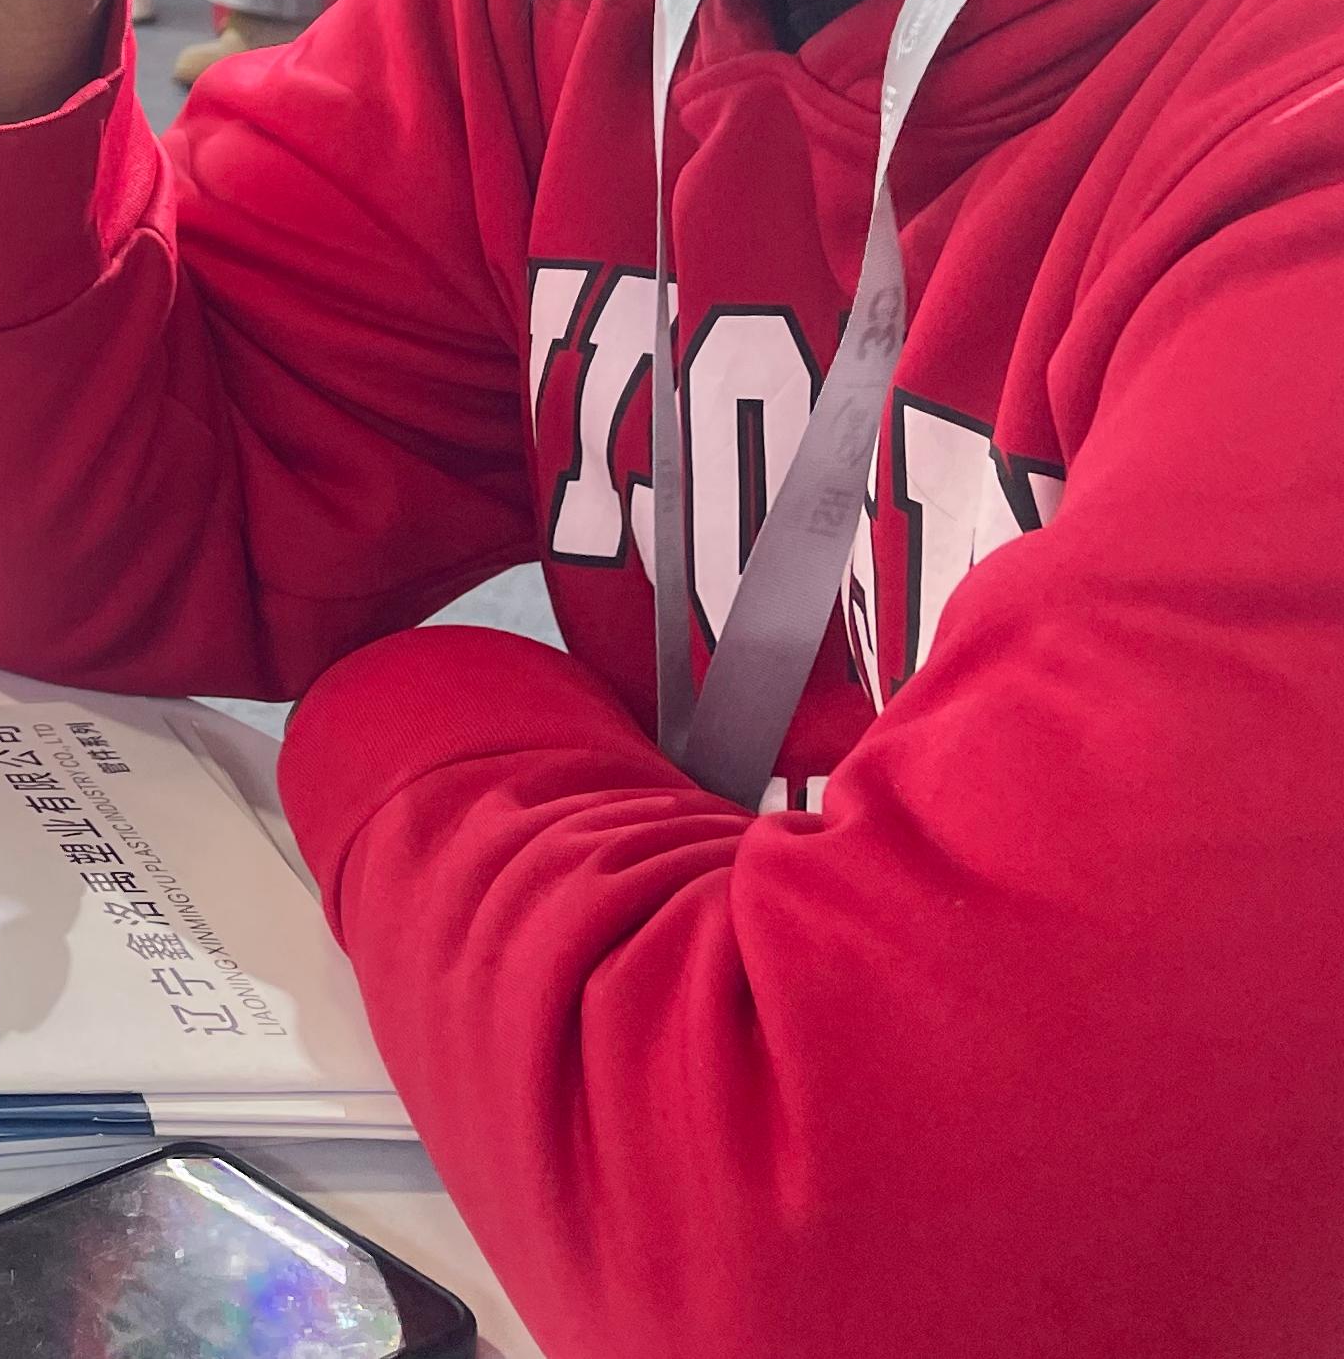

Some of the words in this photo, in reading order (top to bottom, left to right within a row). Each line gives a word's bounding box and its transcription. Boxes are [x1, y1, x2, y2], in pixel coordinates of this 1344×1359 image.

[65, 722, 131, 774] 管件系列
[64, 769, 127, 822] INDUSTRY
[112, 823, 169, 873] PLASTIC
[151, 874, 231, 957] XINMINGYU
[214, 958, 288, 1036] LIAONING
